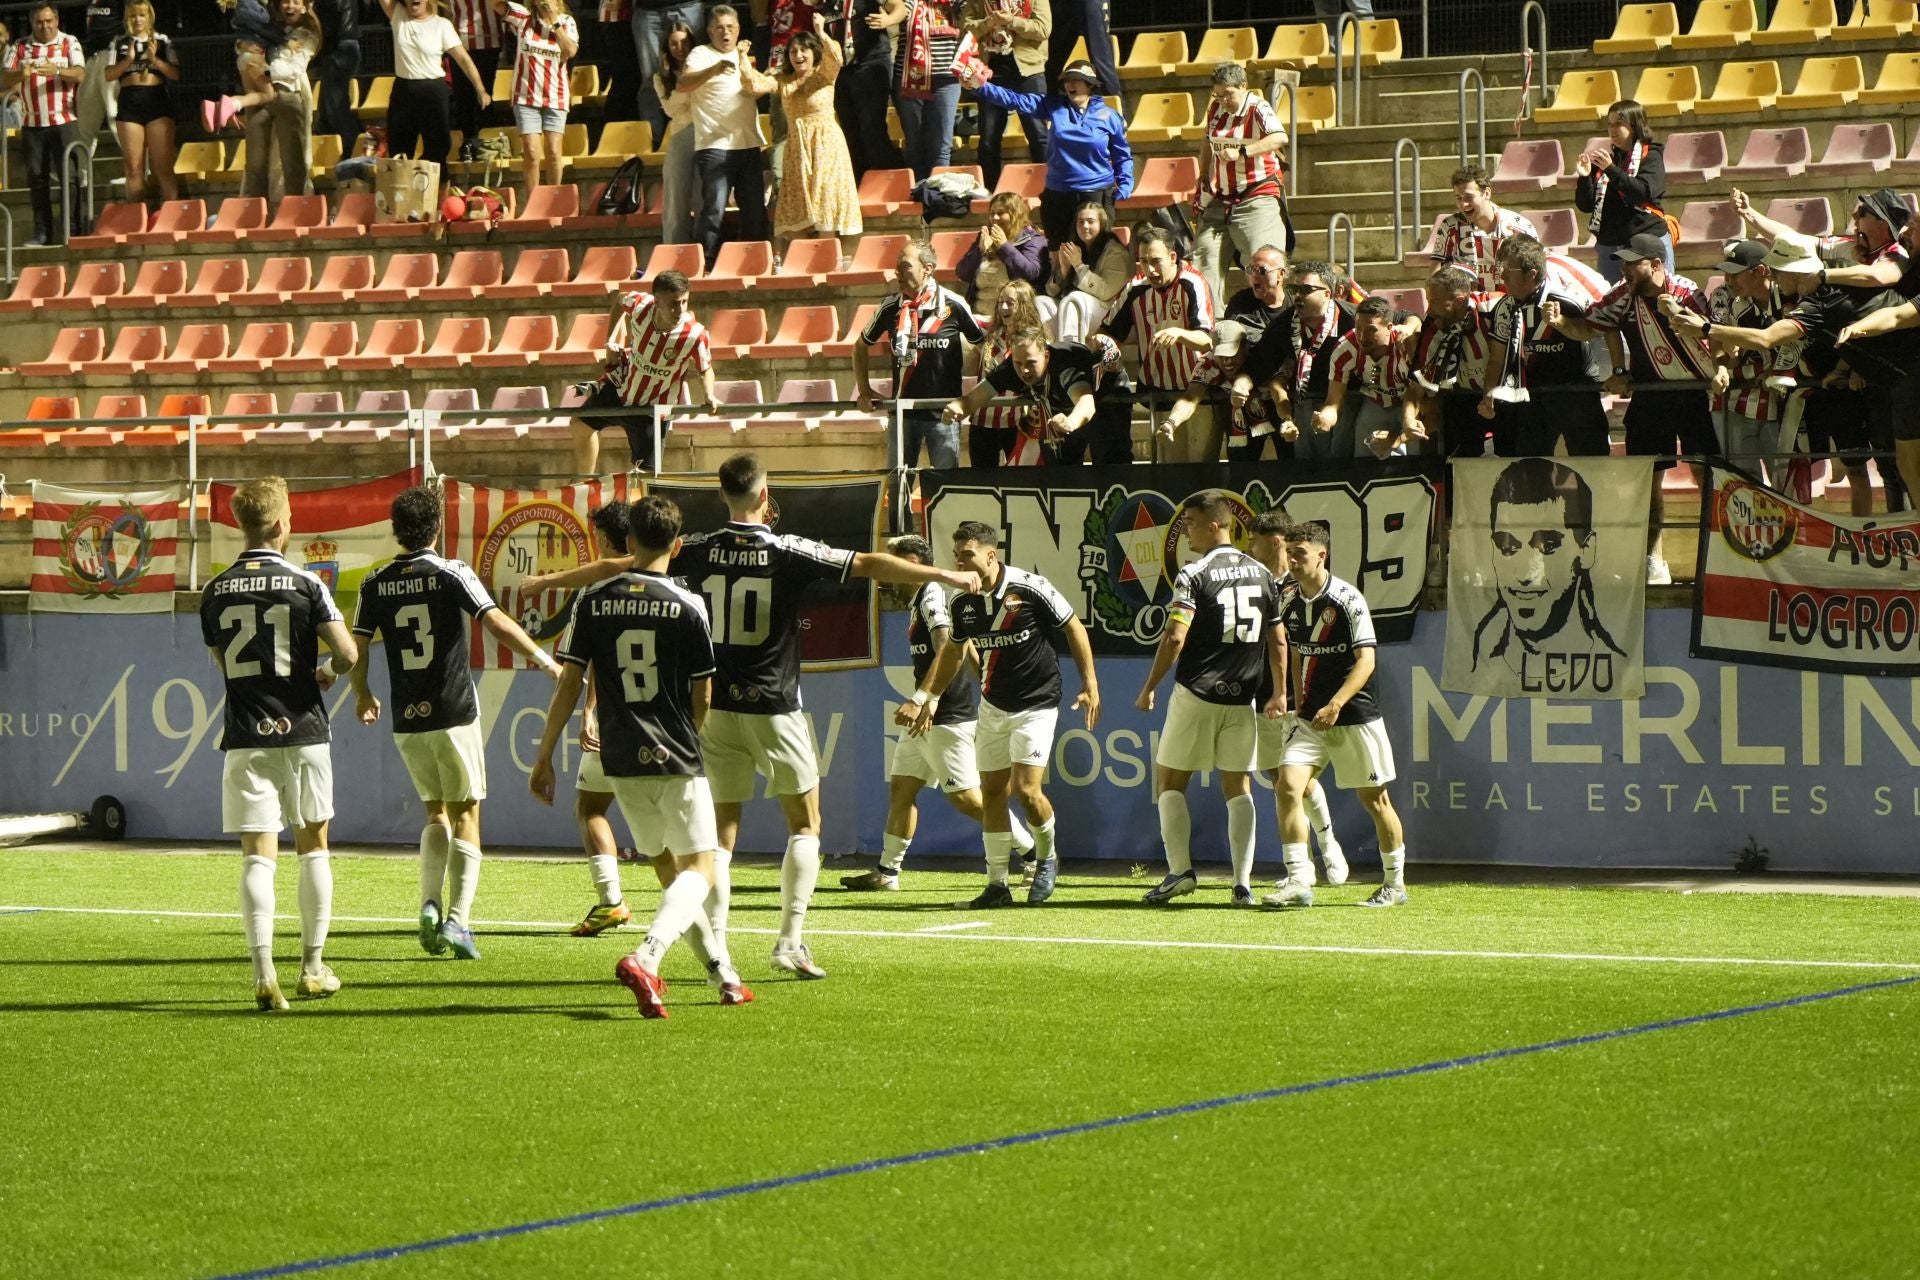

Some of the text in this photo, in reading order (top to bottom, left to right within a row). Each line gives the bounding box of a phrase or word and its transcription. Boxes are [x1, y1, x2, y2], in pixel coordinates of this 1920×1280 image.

[1732, 495, 1754, 525] SDL
[482, 523, 510, 577] SOCIEDAD
[510, 507, 563, 527] DEPORTIVA
[708, 543, 769, 566] ÁLVARO
[1135, 541, 1160, 565] CDL
[214, 575, 297, 596] SERGIO GIL
[378, 575, 442, 597] NACHO R.
[1210, 565, 1262, 582] ARGENTE
[591, 599, 682, 619] LAMADRID
[701, 574, 773, 646] 10
[1216, 585, 1263, 643] 15
[1768, 588, 1920, 652] LOGRO
[219, 604, 291, 679] 21
[395, 604, 434, 671] 3
[616, 629, 660, 703] 8
[1521, 652, 1614, 693] LEDO
[1412, 781, 1544, 811] REAL
[1587, 783, 1828, 816] ESTATES
